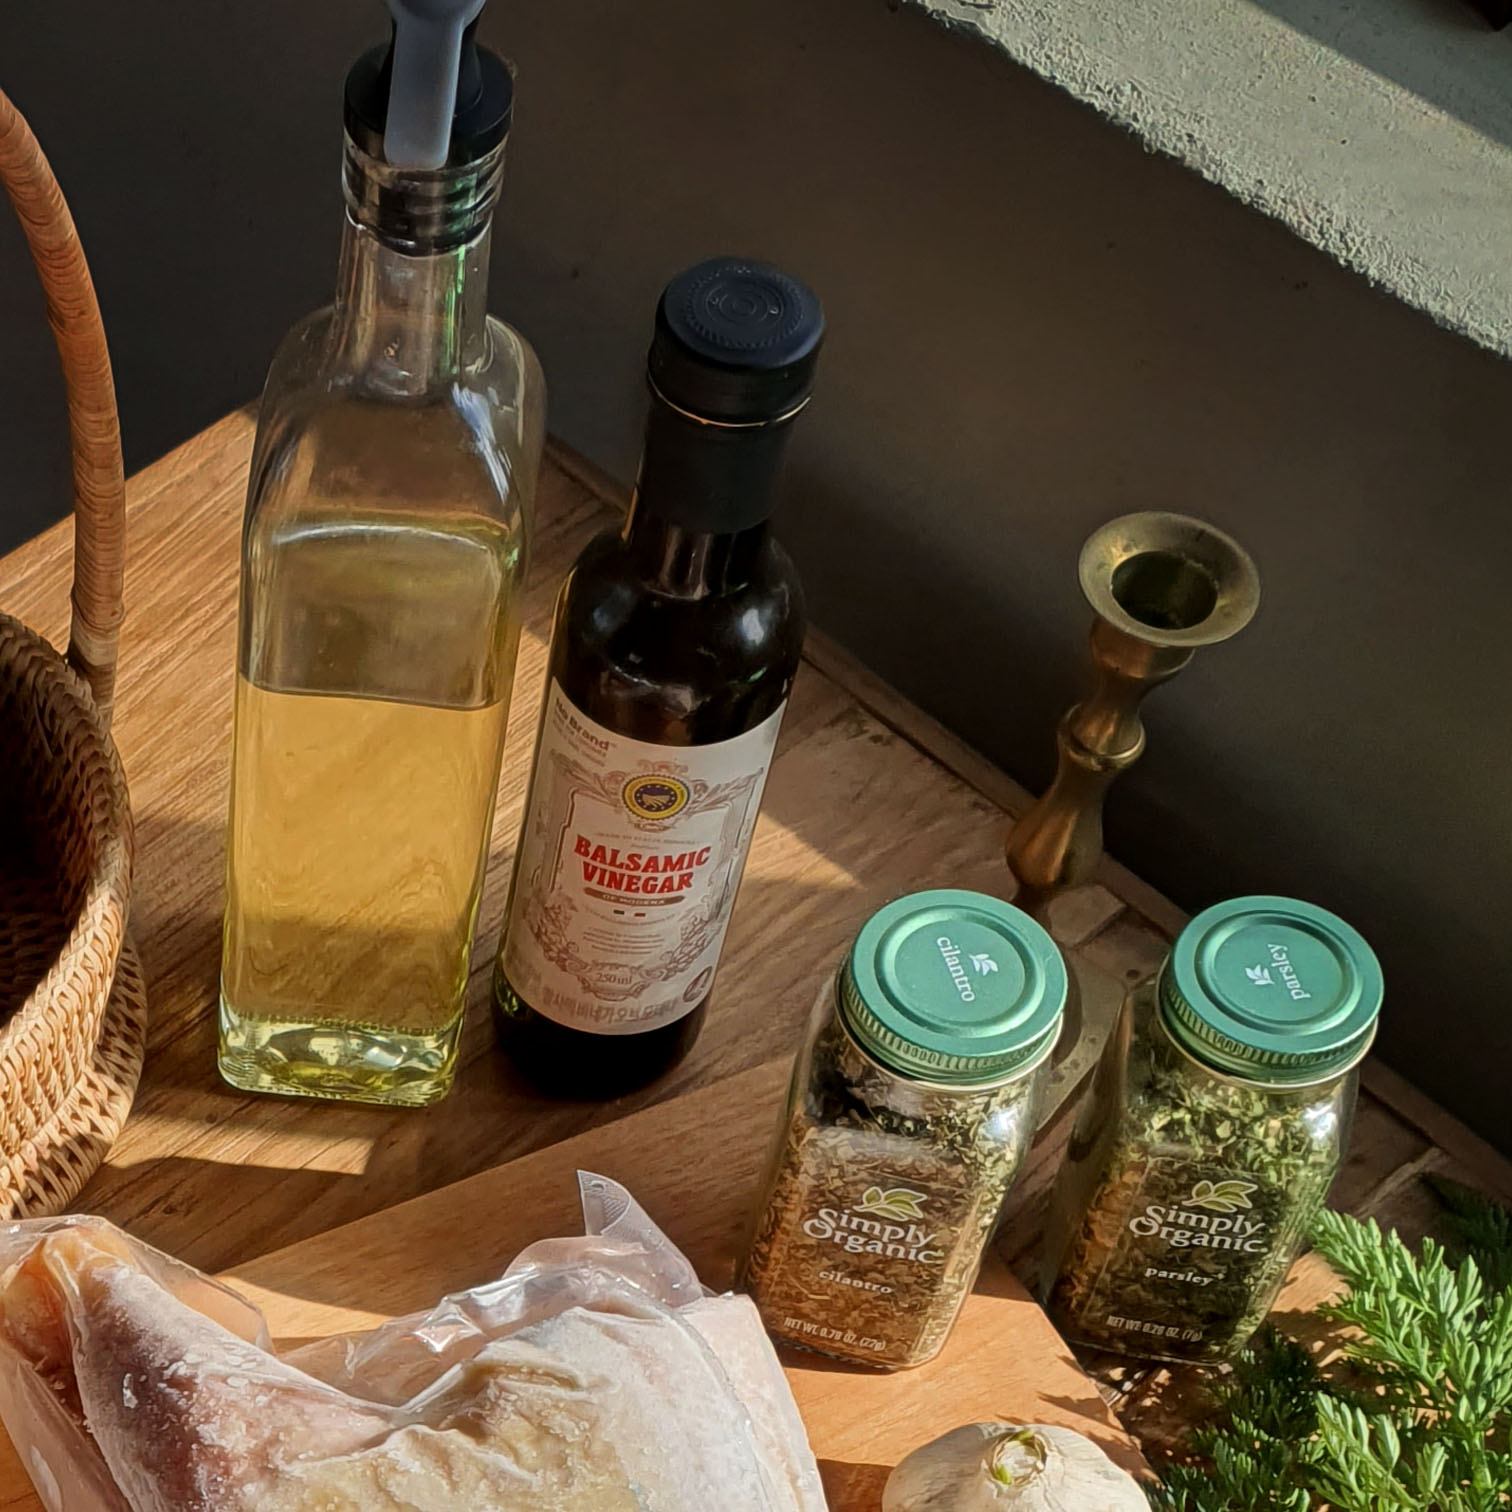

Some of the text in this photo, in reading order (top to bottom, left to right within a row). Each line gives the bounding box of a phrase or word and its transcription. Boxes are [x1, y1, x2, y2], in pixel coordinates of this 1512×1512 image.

[568, 715, 609, 751] Brand
[574, 834, 712, 874] BALSAMIC
[582, 861, 694, 894] VINEGAR
[936, 936, 976, 1002] cilantro
[1267, 943, 1312, 1000] parsley
[818, 1208, 938, 1248] Simply
[1145, 1205, 1266, 1238] Simply
[818, 1270, 894, 1294] cilantro
[783, 1316, 802, 1331] NET
